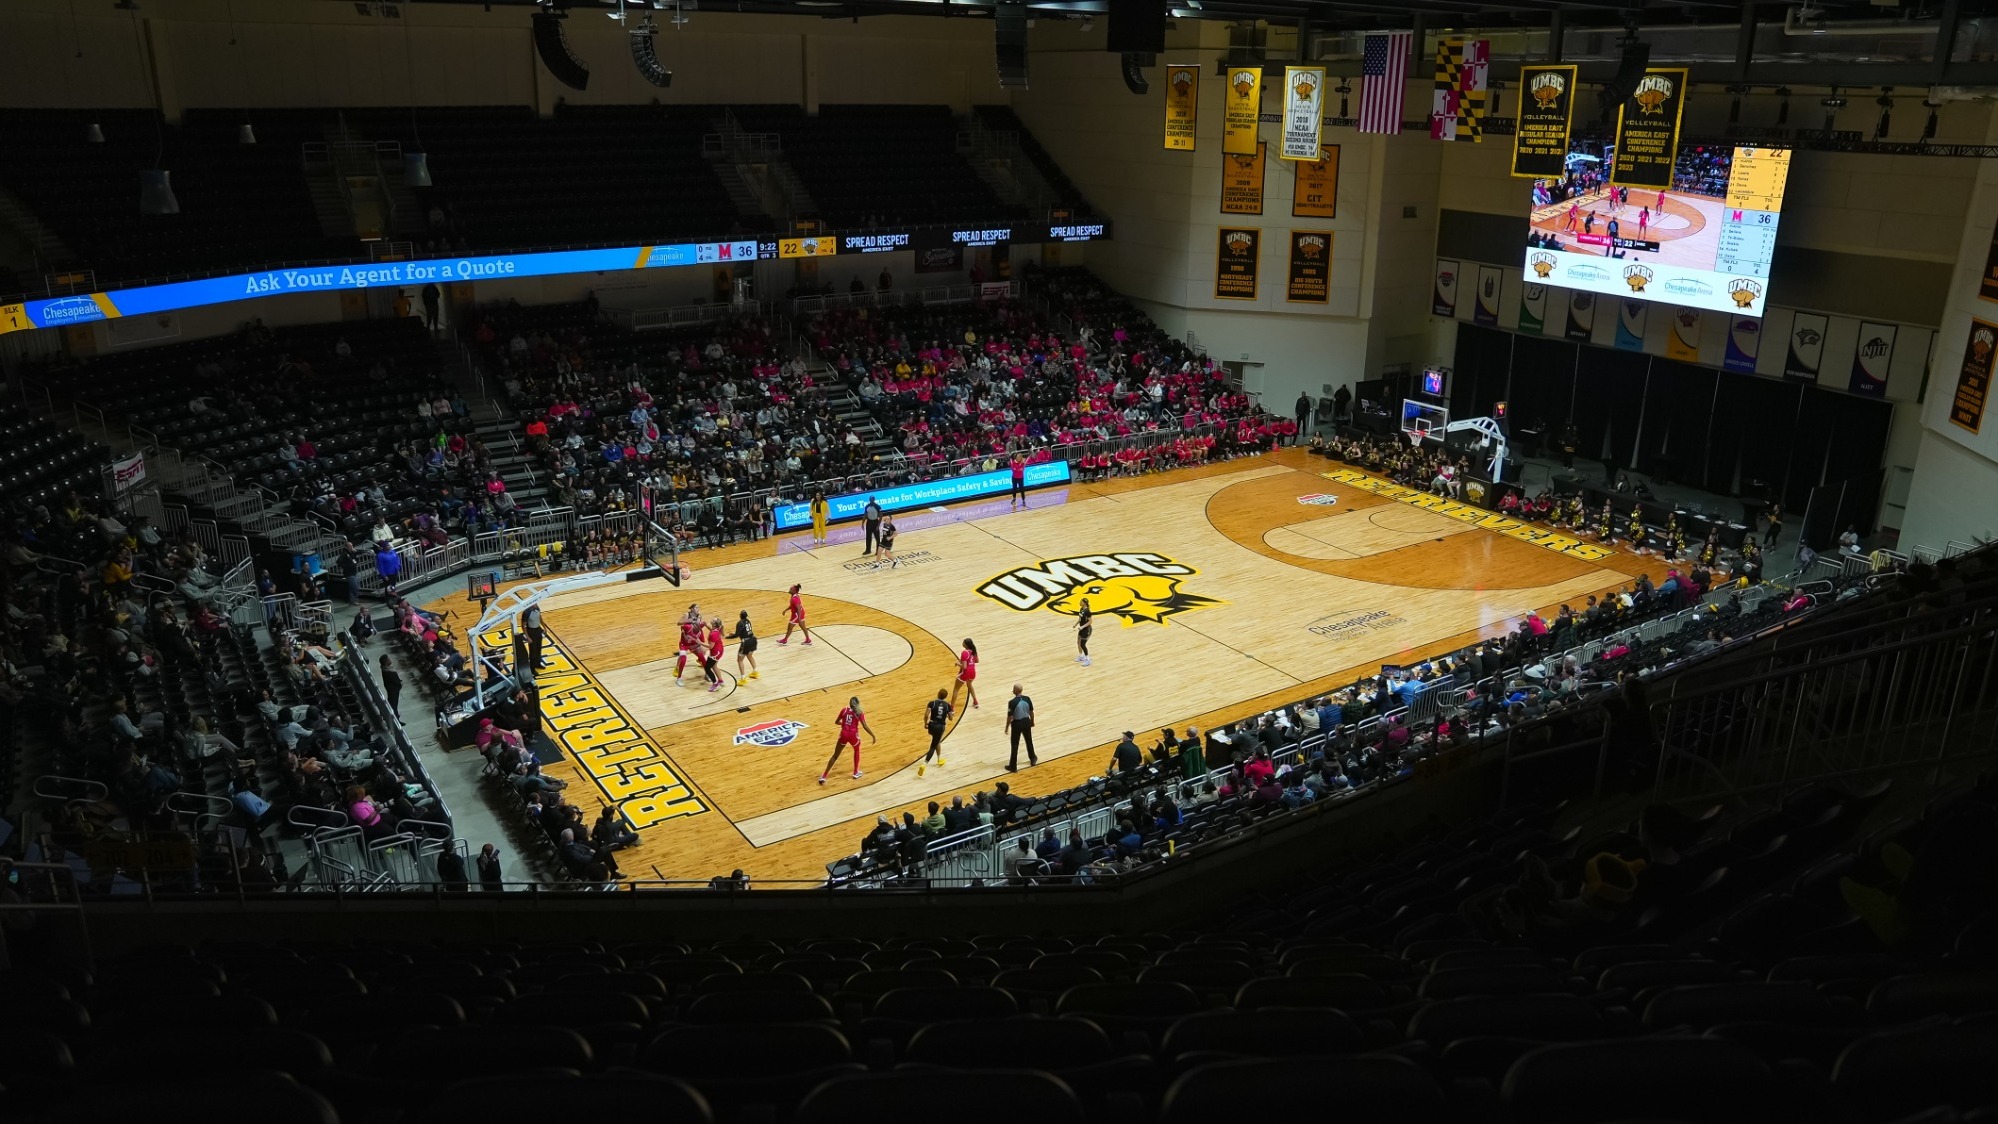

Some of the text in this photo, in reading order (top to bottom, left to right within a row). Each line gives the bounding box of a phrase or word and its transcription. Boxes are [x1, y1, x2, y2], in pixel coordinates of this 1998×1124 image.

[1233, 72, 1255, 86] UMBC
[1293, 72, 1317, 88] UMBC
[1531, 73, 1565, 92] UMBC
[1624, 130, 1670, 139] AMERICA EAST
[1627, 138, 1666, 146] CONFERENCE
[1732, 210, 1743, 221] M
[1758, 215, 1771, 224] 36
[953, 229, 1011, 242] SPREAD RESPECT
[1050, 225, 1104, 237] SPREAD RESPECT
[846, 234, 909, 248] SPREAD RESPECT
[1226, 233, 1252, 245] UMBC
[1299, 237, 1324, 248] UMBC
[718, 244, 733, 260] M
[738, 246, 753, 257] 36
[760, 243, 776, 251] 9:22
[784, 243, 797, 254] 22
[1531, 252, 1557, 269] UMBC
[246, 260, 515, 293] Ask Your Agent for a Quote
[1568, 268, 1596, 279] Chesapeake
[1596, 272, 1610, 280] Arena
[1623, 265, 1653, 282] UMBC
[1665, 282, 1697, 296] Chesapeake
[1697, 287, 1713, 296] Arena
[1728, 279, 1761, 298] UMBC
[43, 303, 101, 320] Chesapeake
[11, 316, 17, 327] 1
[1861, 344, 1889, 359] NJIT
[1026, 469, 1060, 481] Chesapeake
[837, 503, 857, 512] Your
[901, 494, 912, 502] for
[914, 487, 956, 499] Workplace
[956, 482, 981, 496] Safety
[989, 477, 1012, 487] Saving
[1466, 482, 1485, 495] UMBC
[1321, 469, 1619, 560] RETRIEVERS
[901, 555, 942, 567] Arena
[978, 553, 1197, 611] UMBC
[1308, 610, 1391, 635] Chesapeake
[1366, 617, 1407, 631] Arena
[937, 707, 943, 715] 5
[846, 715, 853, 723] 15
[736, 722, 805, 743] AMERICA
[753, 730, 791, 743] EAST
